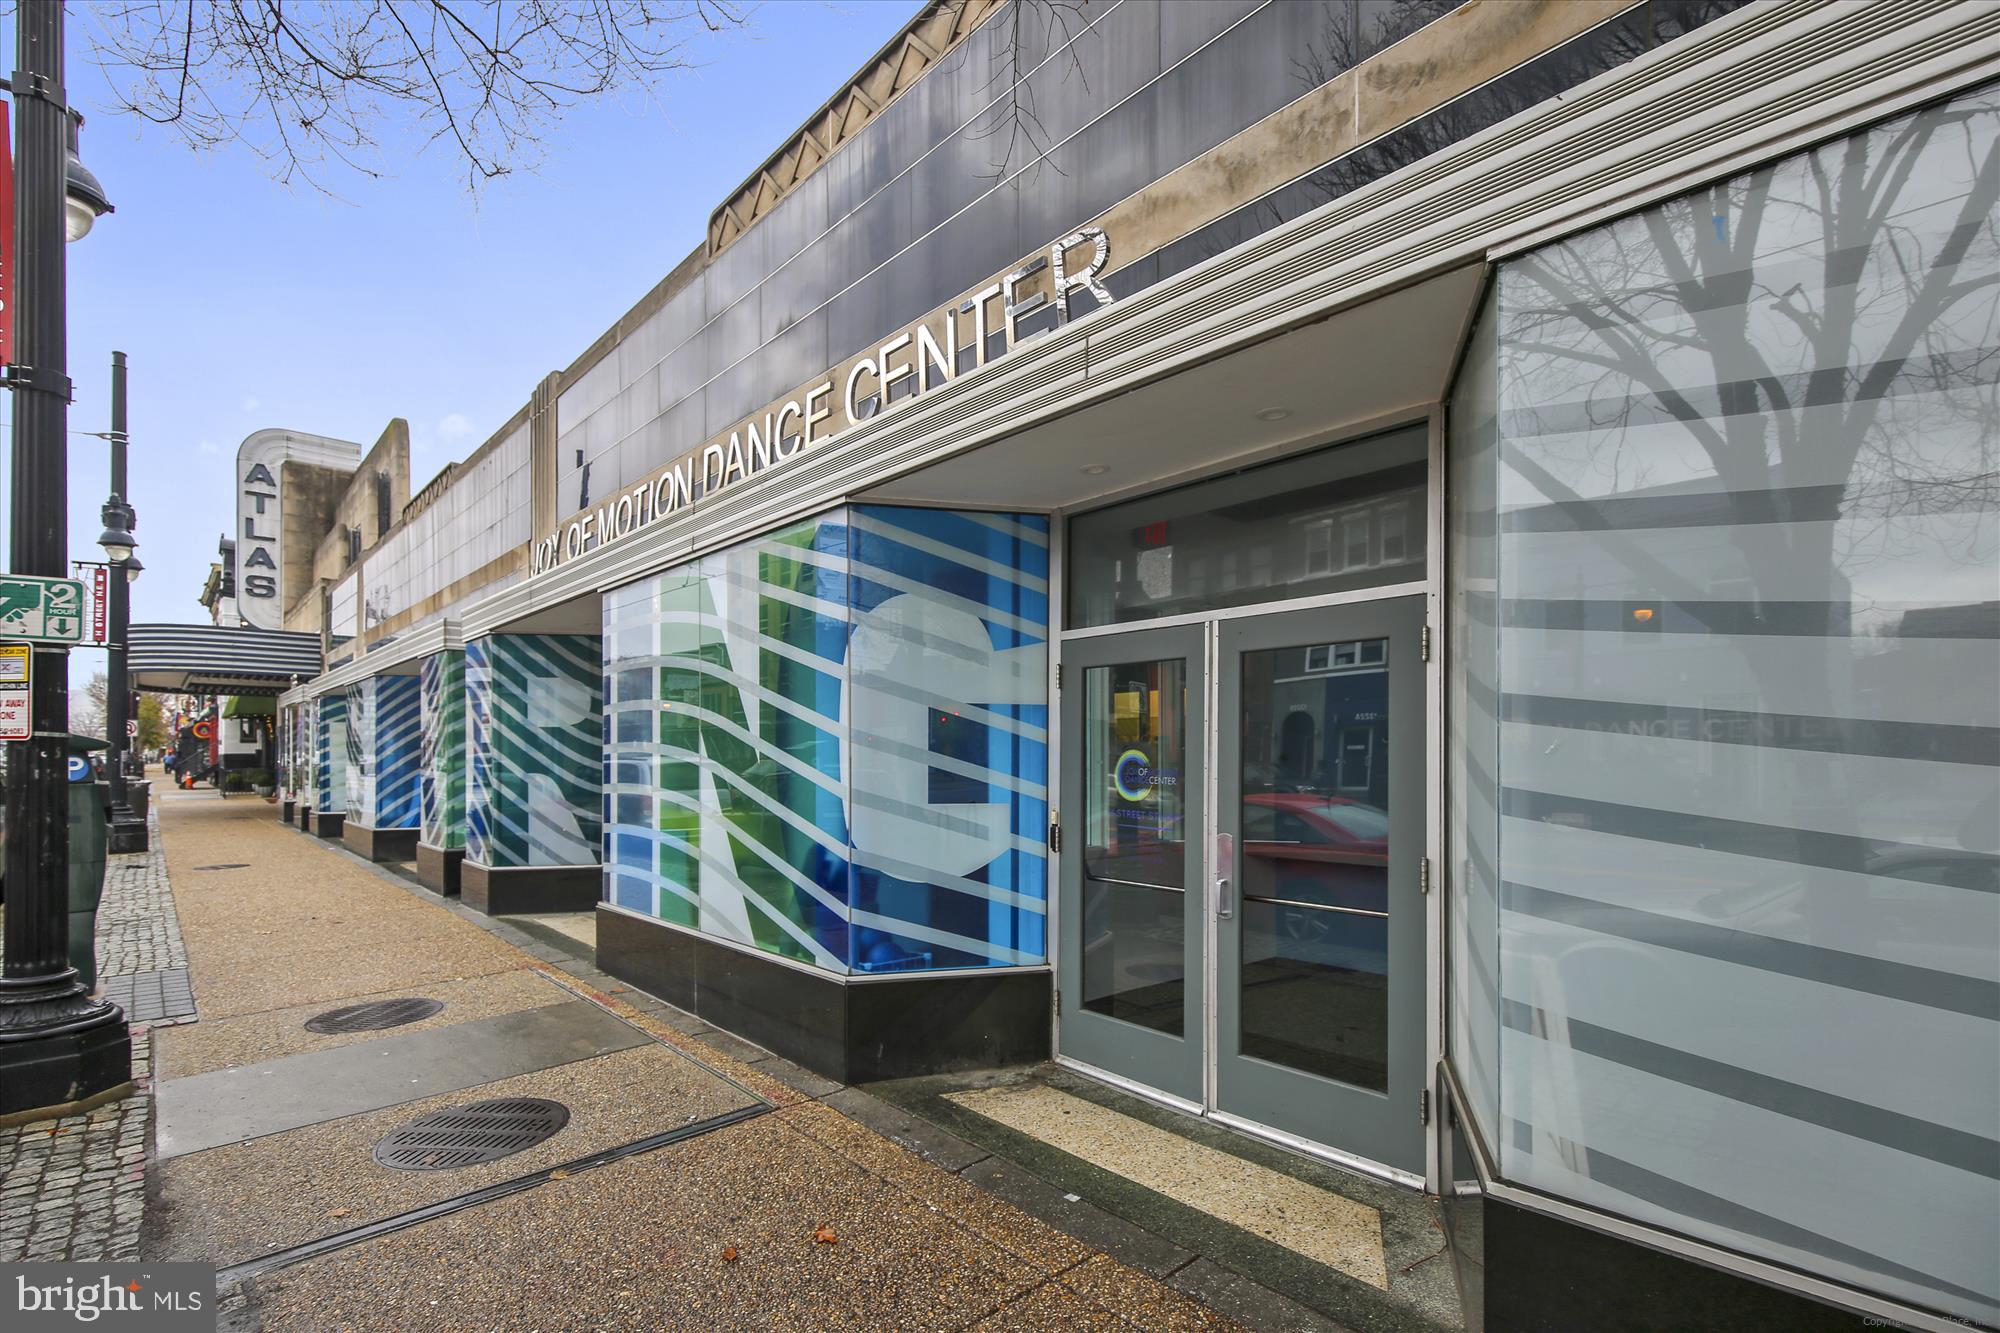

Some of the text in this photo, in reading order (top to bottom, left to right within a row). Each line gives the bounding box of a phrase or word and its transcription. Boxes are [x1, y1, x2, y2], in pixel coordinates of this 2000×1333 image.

[531, 226, 1114, 577] JOY OF MOTION DANCE CENTER
[244, 463, 277, 598] ATLAS
[49, 583, 77, 609] 2
[5, 699, 25, 707] AWAY
[0, 711, 16, 720] ONE
[1137, 767, 1149, 776] OF
[1148, 776, 1177, 786] CENTER
